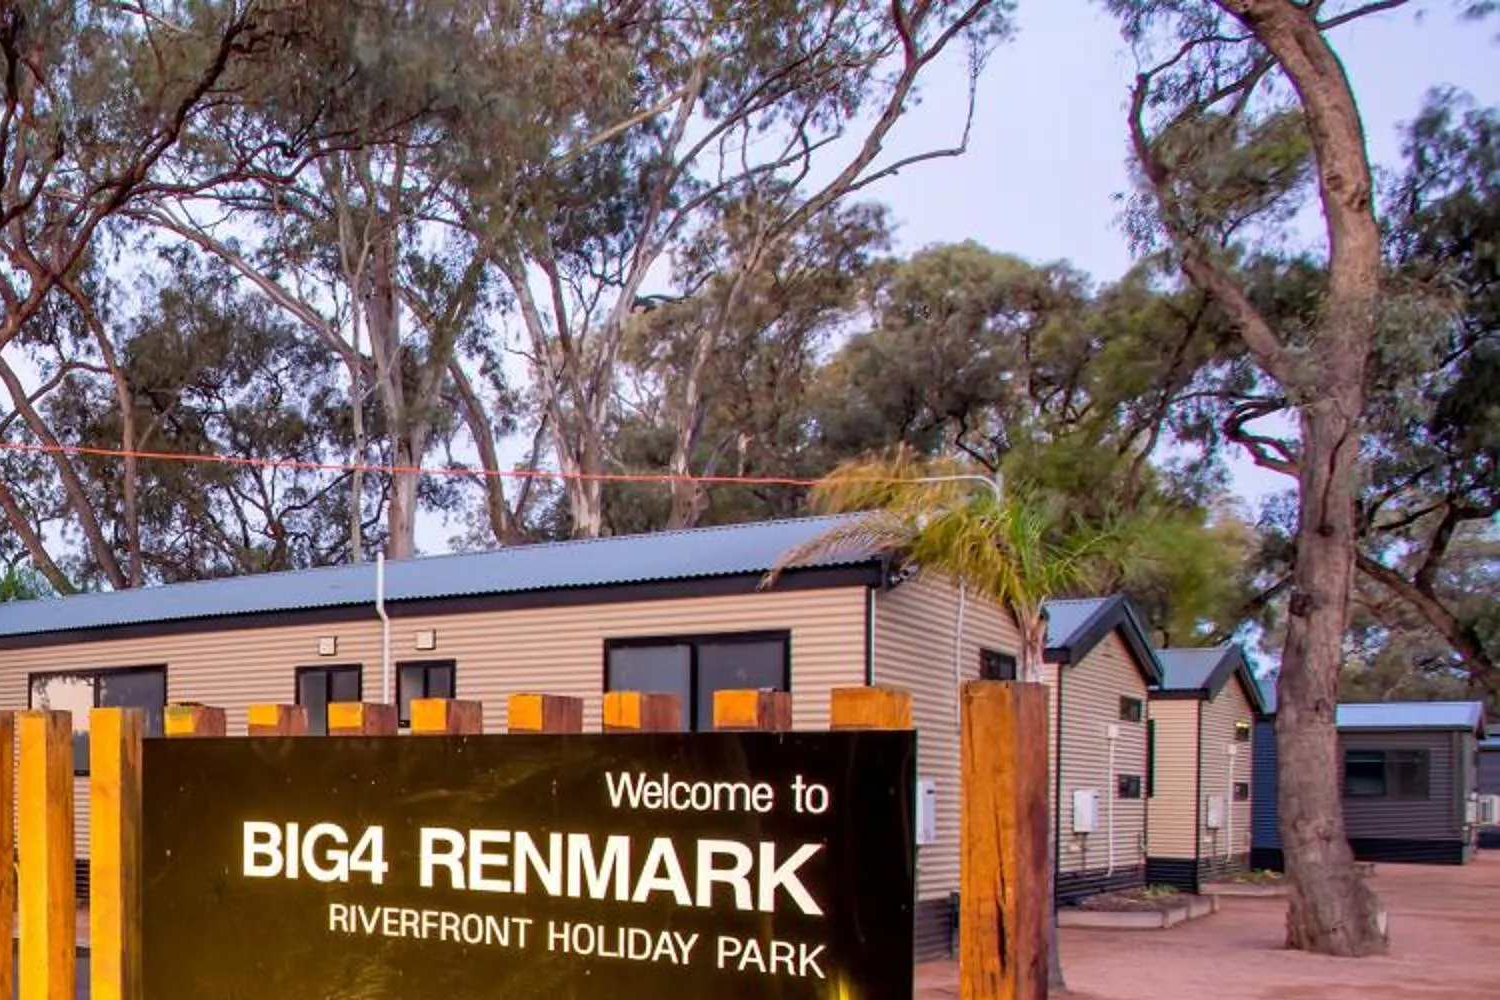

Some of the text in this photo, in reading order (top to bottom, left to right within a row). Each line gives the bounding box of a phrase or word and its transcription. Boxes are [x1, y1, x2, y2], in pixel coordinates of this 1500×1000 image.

[605, 772, 829, 813] Welcome to
[242, 820, 824, 916] BIG4 RENMARK
[329, 903, 827, 979] RIVERFRONT HOLIDAY PARK
